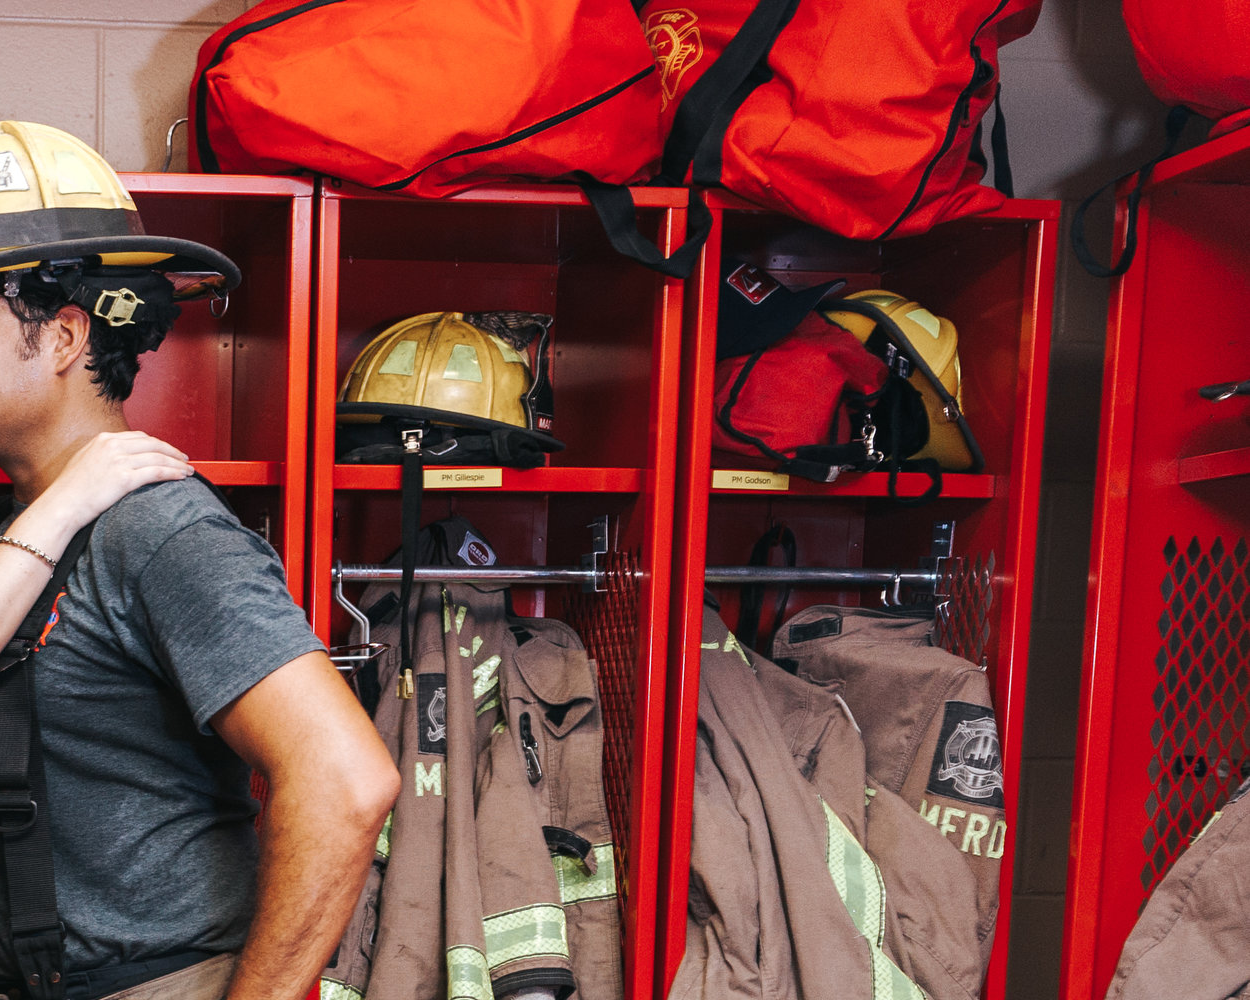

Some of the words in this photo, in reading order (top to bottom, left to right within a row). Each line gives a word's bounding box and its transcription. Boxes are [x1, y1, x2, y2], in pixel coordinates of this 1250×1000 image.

[441, 473, 453, 481] PM
[454, 472, 485, 482] Gillespie
[731, 475, 743, 483] PM
[744, 476, 772, 484] Godson
